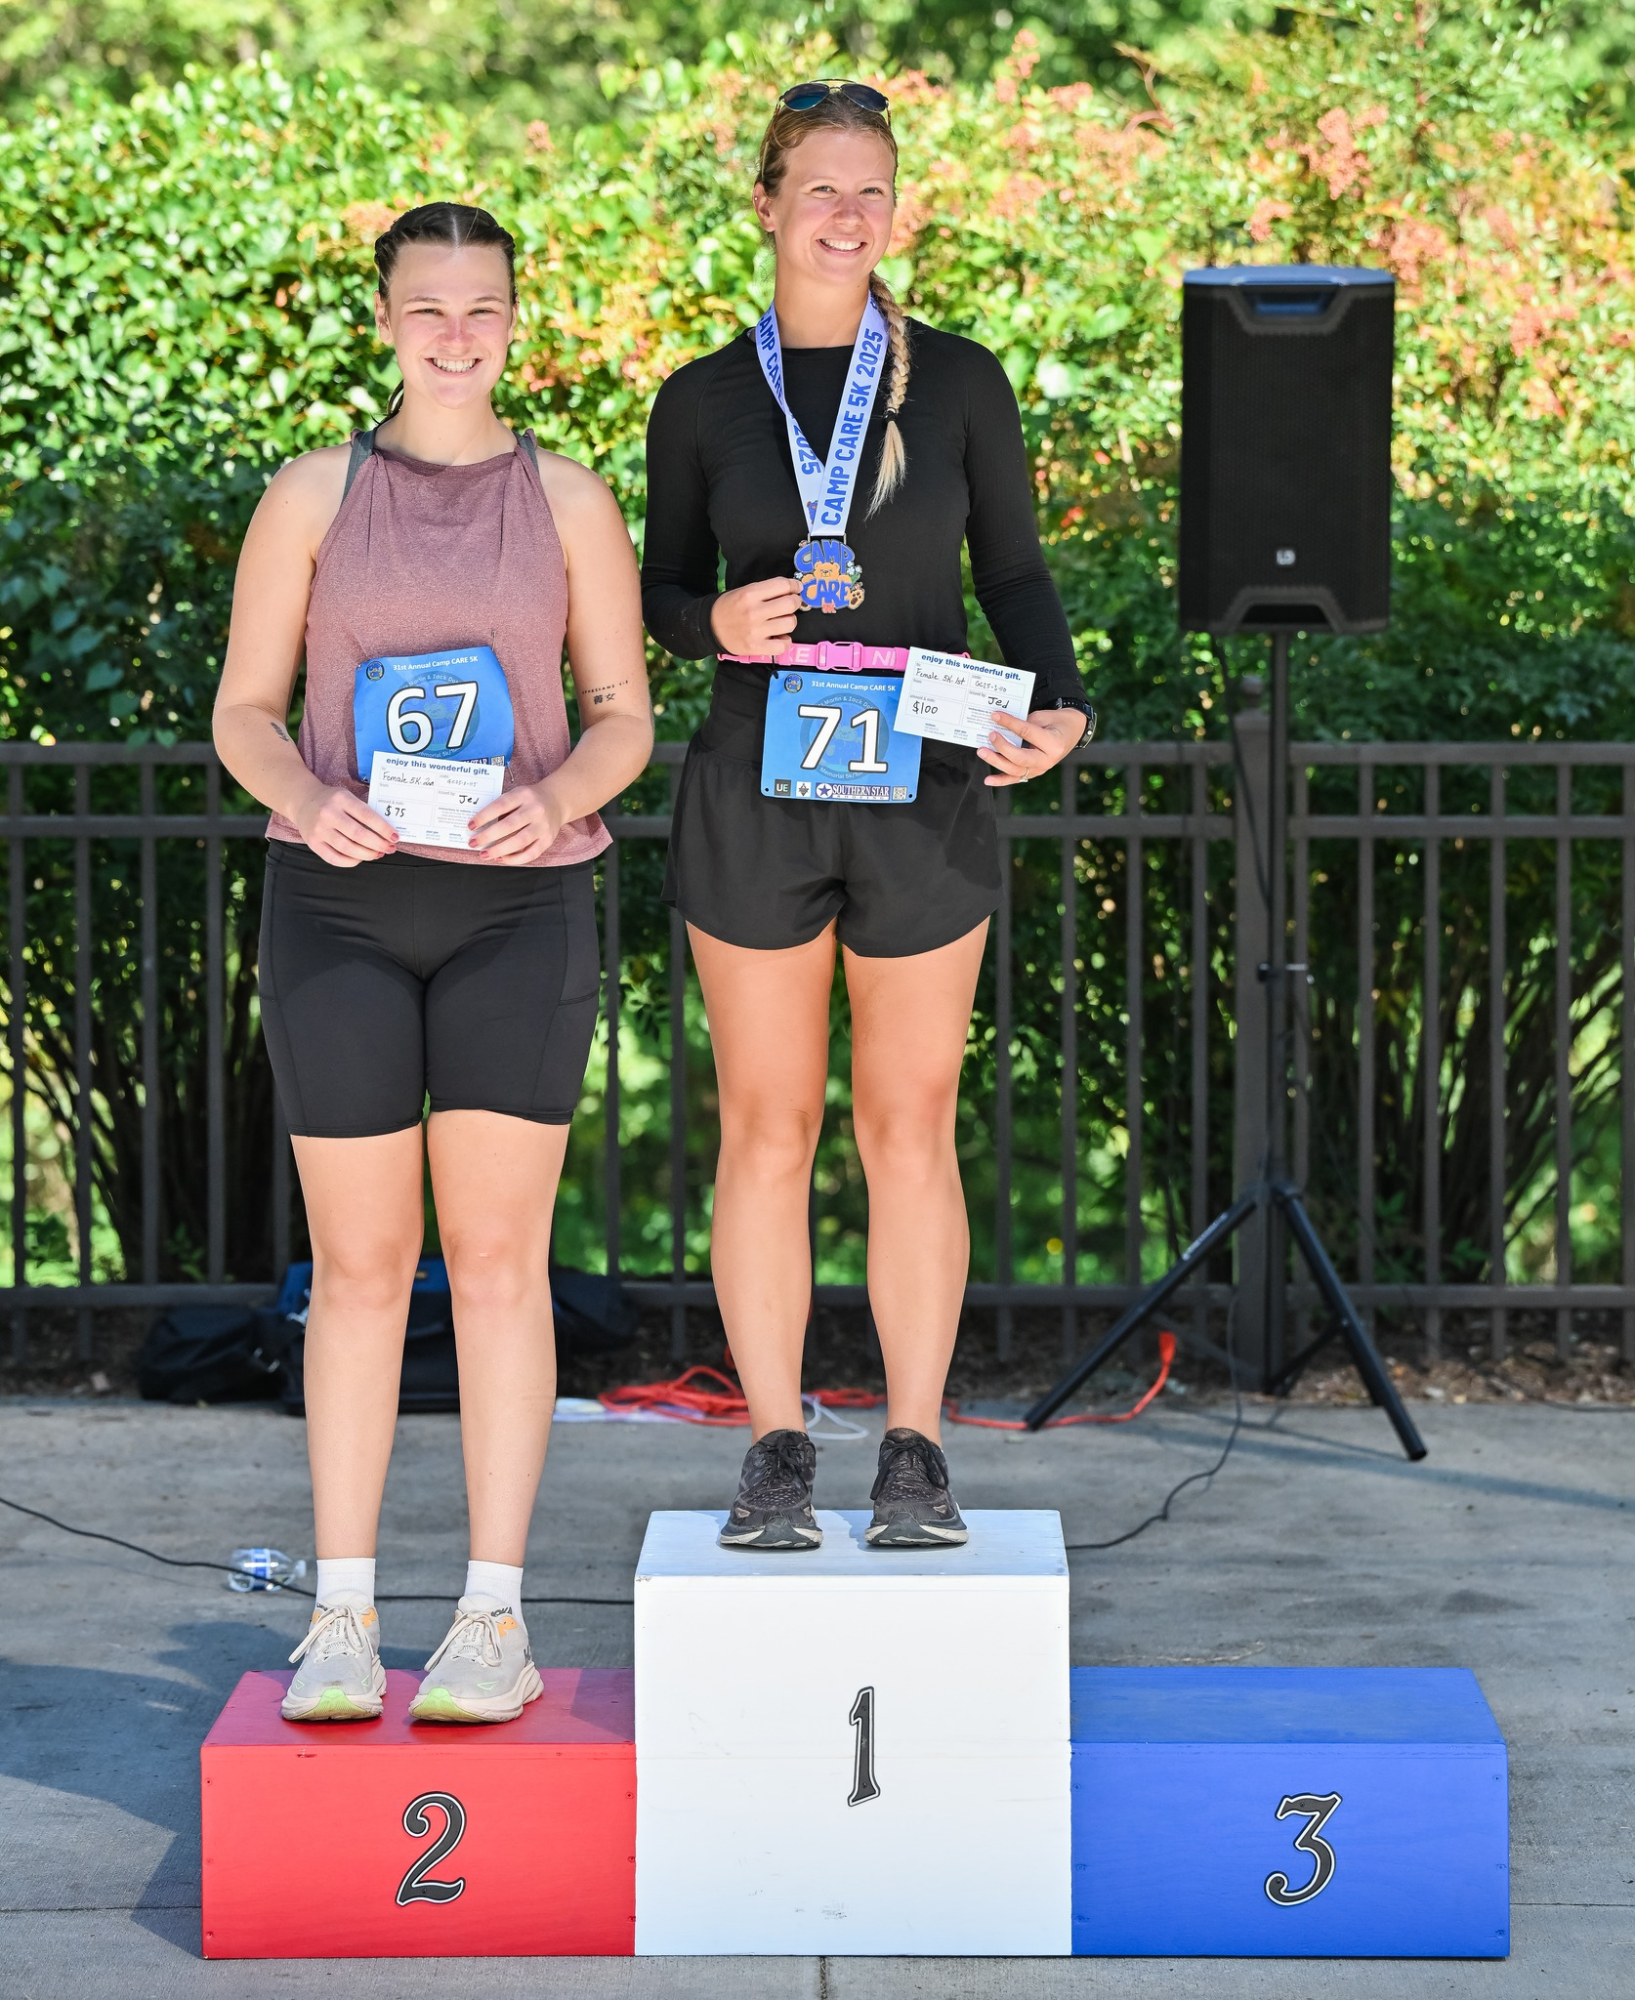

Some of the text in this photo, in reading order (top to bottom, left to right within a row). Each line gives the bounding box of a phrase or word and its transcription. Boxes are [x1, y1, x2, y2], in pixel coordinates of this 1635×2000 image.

[760, 313, 776, 352] AMP
[821, 328, 883, 526] CAMP CARE 5K 2025
[795, 540, 855, 574] CAMP
[800, 578, 852, 608] CARE
[916, 668, 939, 680] Female
[922, 654, 1021, 681] enjoy this wonderful gift.
[912, 700, 938, 714] $100
[988, 696, 1010, 708] Jed
[386, 681, 479, 754] 67
[798, 704, 888, 774] 71
[383, 771, 408, 783] Female
[386, 758, 408, 767] enjoy
[429, 763, 471, 773] wonderful
[459, 795, 479, 805] Jed
[776, 783, 788, 792] UE
[832, 784, 889, 796] SOUTHERN STAR
[848, 1686, 880, 1807] 1
[395, 1790, 467, 1906] 2
[1264, 1791, 1343, 1907] 3
